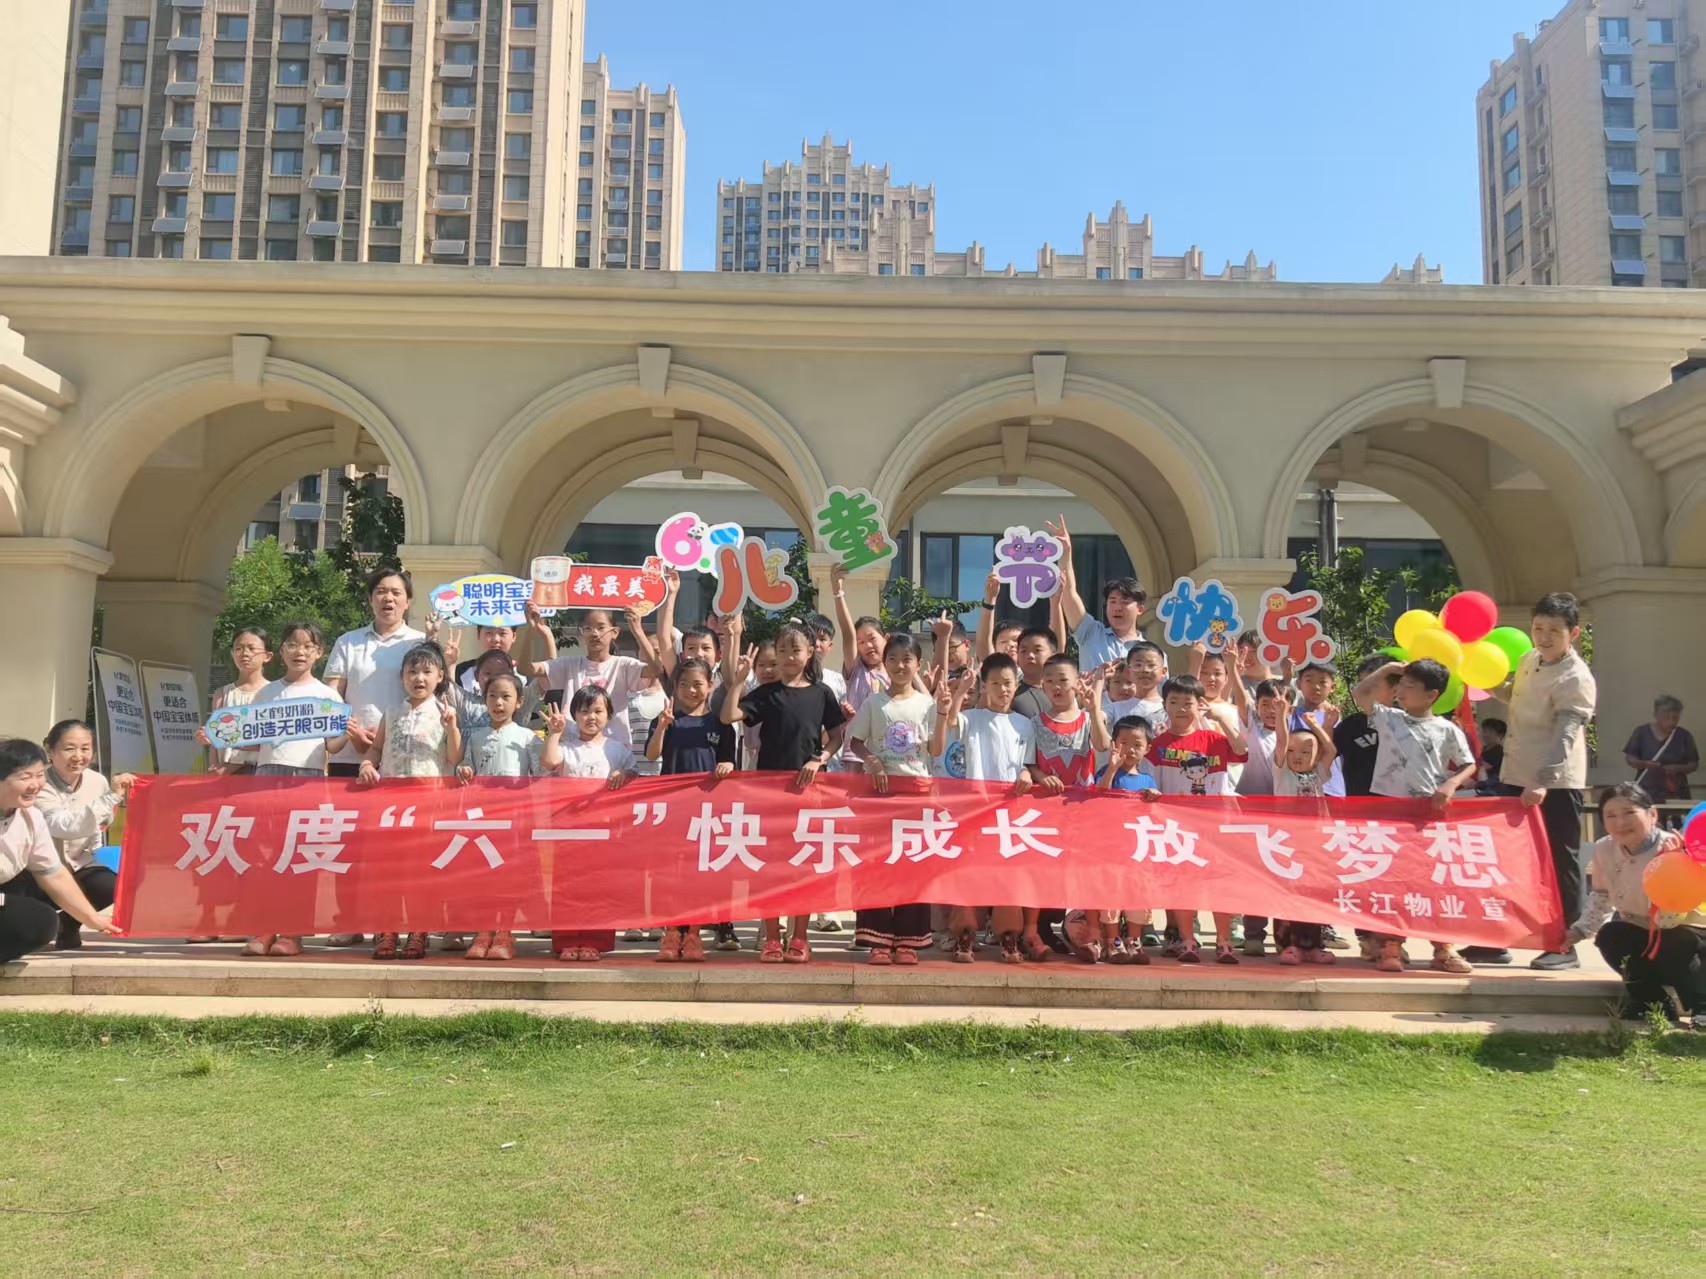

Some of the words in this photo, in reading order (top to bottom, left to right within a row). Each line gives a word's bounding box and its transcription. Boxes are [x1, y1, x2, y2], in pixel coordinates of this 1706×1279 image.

[818, 490, 892, 572] 童
[573, 574, 645, 599] 我最美
[718, 543, 792, 613] 儿
[998, 535, 1061, 603] 节
[470, 600, 554, 616] 未来可
[1161, 582, 1240, 646] 快
[1262, 590, 1331, 666] 乐
[162, 695, 187, 709] 更适合
[242, 715, 347, 740] 创造无限可能
[1124, 815, 1508, 888] 放飞梦想
[1333, 889, 1468, 920] 长江物业
[1480, 893, 1508, 921] 宣
